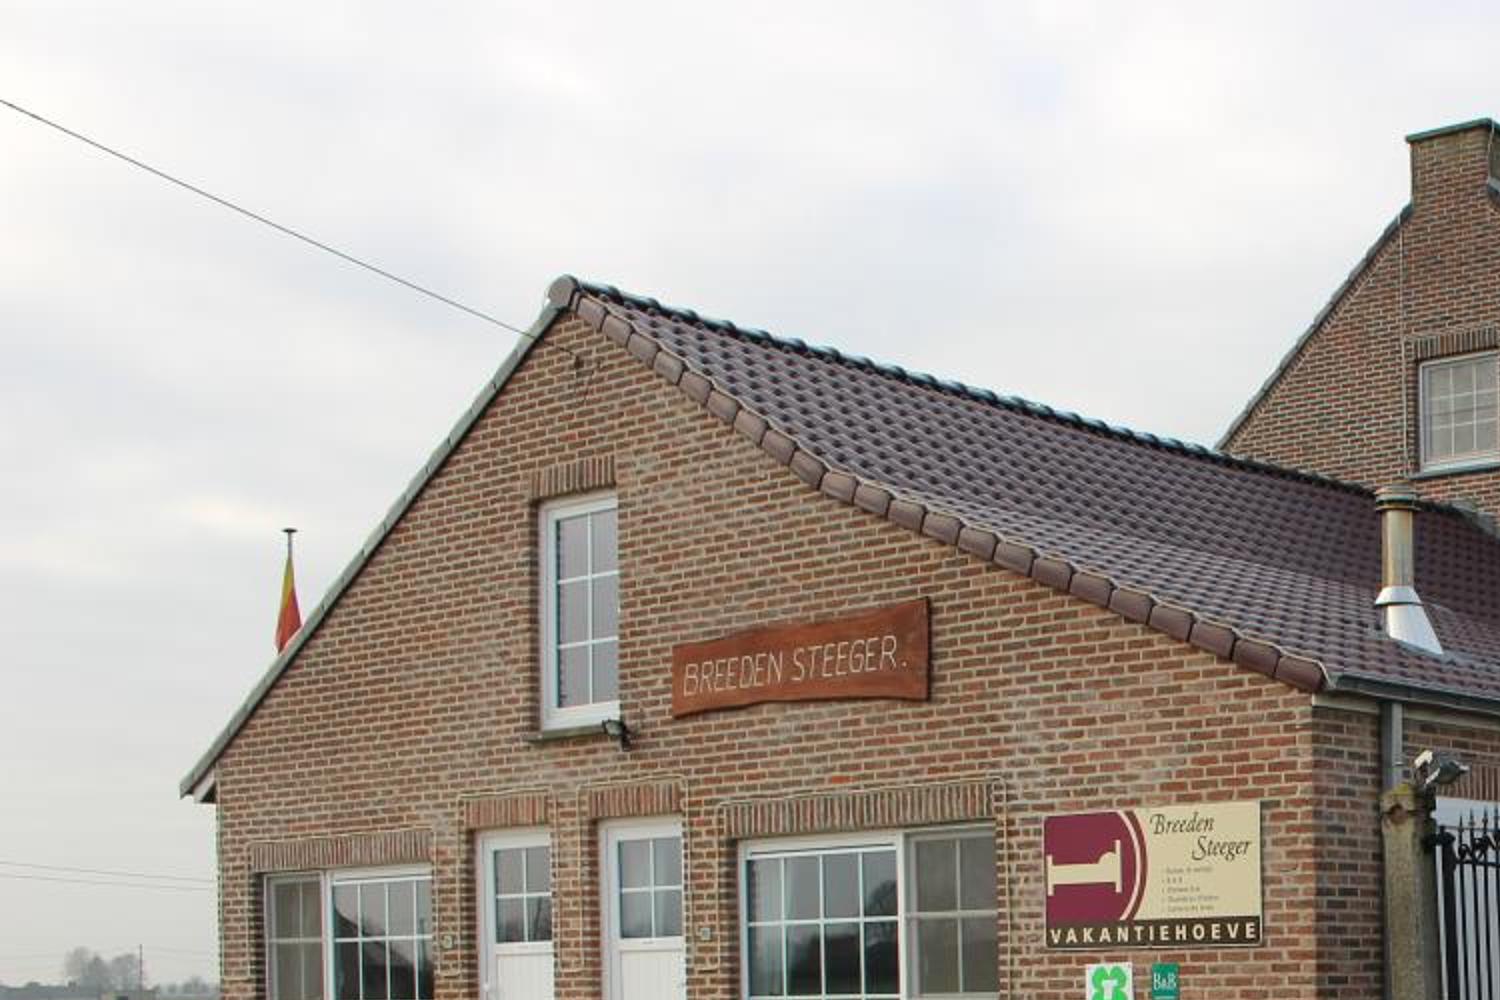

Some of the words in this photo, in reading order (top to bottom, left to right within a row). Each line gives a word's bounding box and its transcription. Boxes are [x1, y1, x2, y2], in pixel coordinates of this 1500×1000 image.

[683, 651, 783, 697] BREEDEN
[1150, 811, 1215, 835] Breeden
[1191, 835, 1252, 862] Steeger
[1051, 922, 1256, 944] VAKANTIEHOEVE
